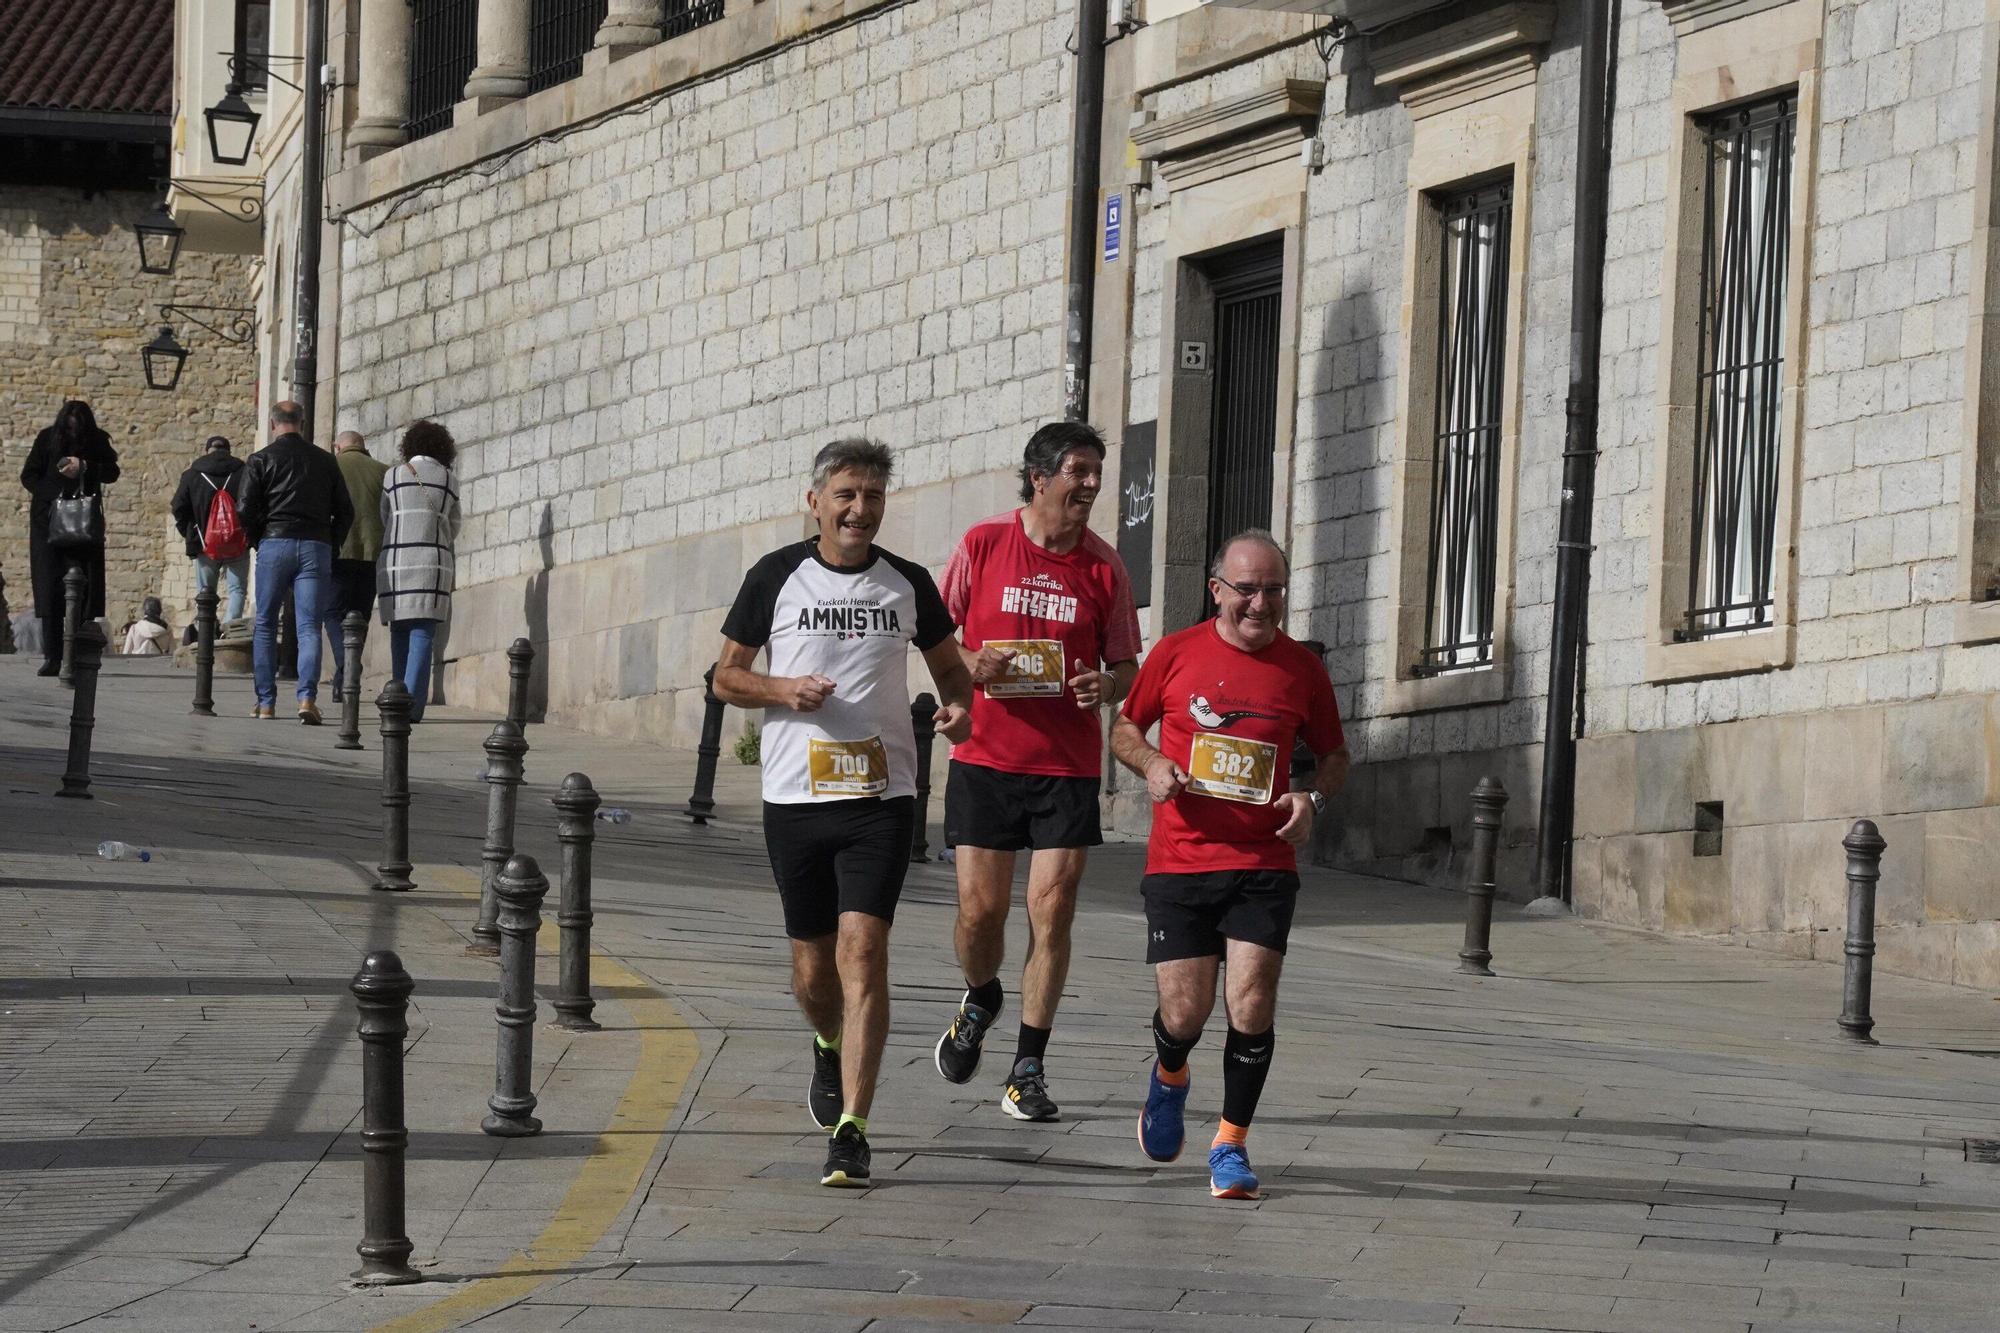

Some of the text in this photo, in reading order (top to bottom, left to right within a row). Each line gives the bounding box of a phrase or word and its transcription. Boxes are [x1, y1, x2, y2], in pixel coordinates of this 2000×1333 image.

[797, 607, 901, 633] AMNISTIA
[1005, 653, 1045, 677] 296
[830, 753, 870, 776] 700
[1212, 750, 1255, 779] 382
